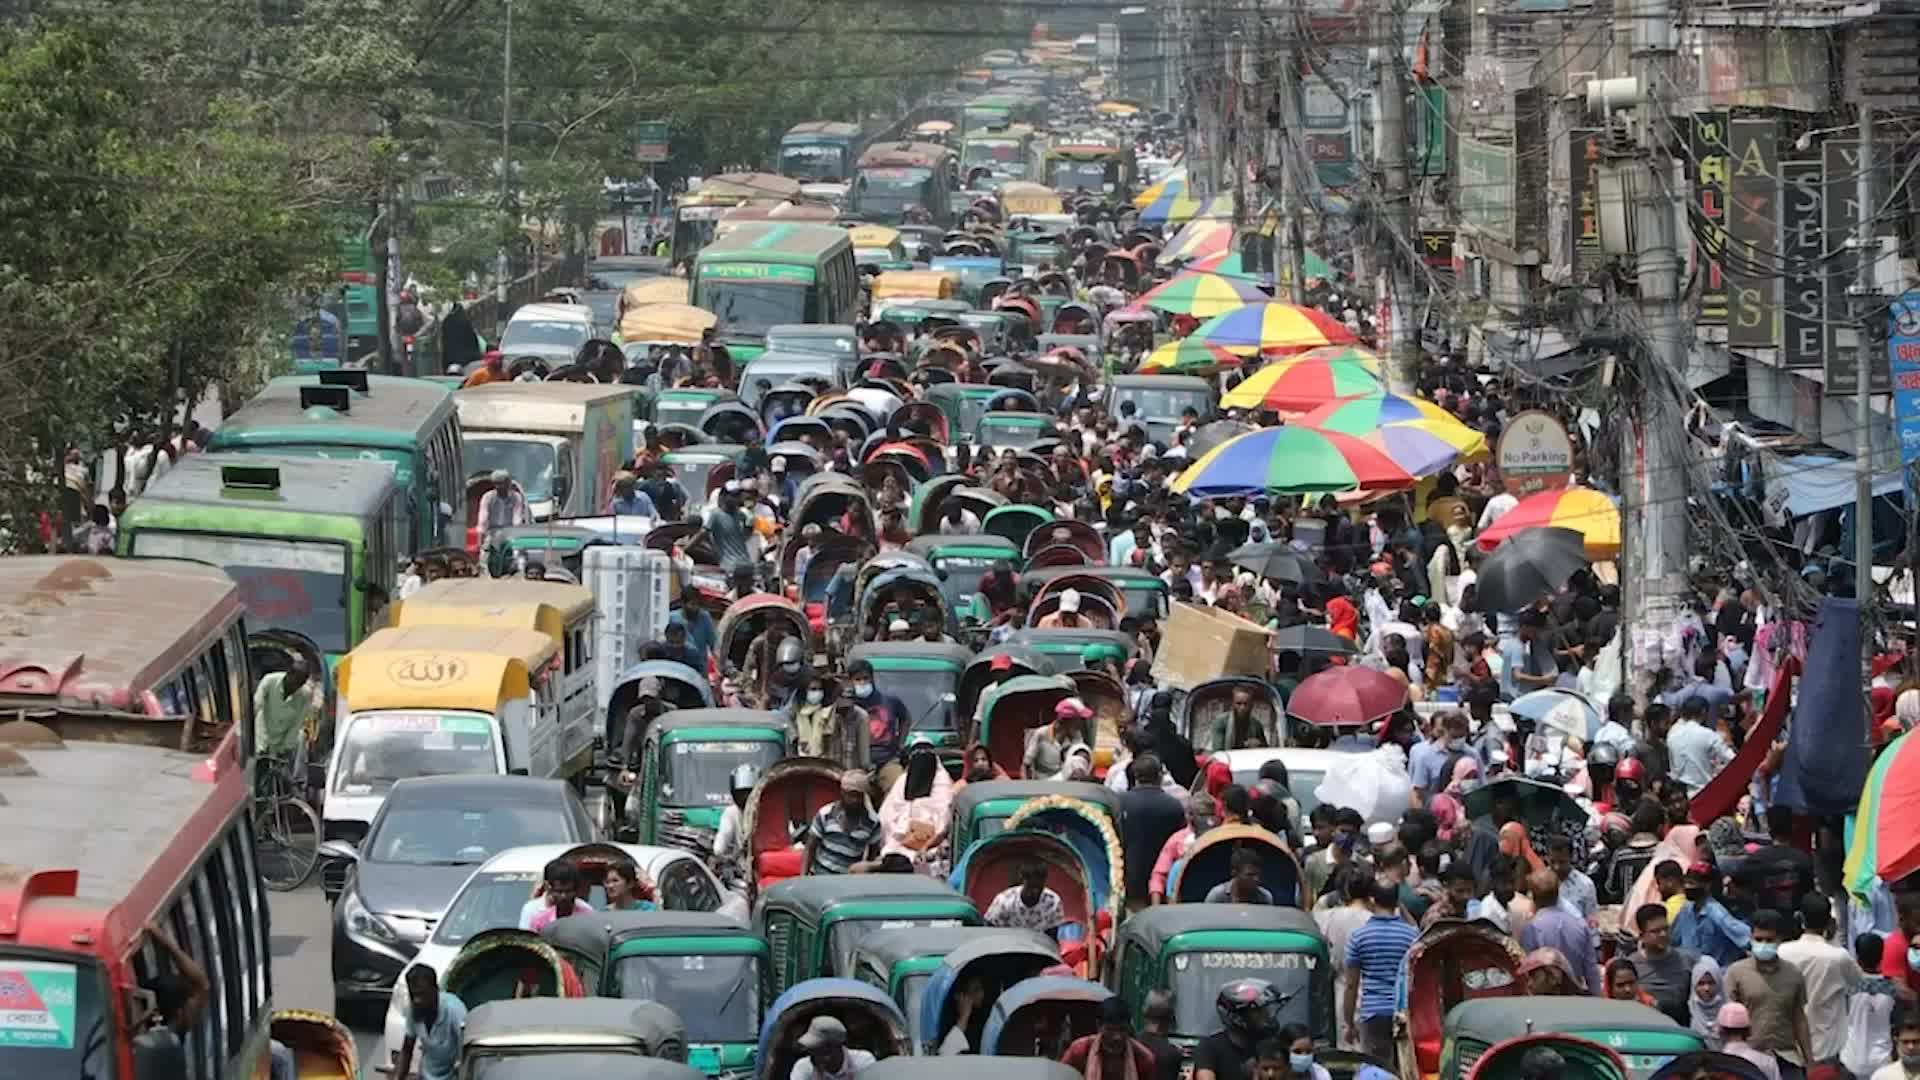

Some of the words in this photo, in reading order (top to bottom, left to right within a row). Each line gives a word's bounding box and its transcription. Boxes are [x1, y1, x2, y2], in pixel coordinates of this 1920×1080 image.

[1735, 138, 1768, 328] AXIS
[1503, 451, 1520, 463] No
[1521, 450, 1567, 465] Parking
